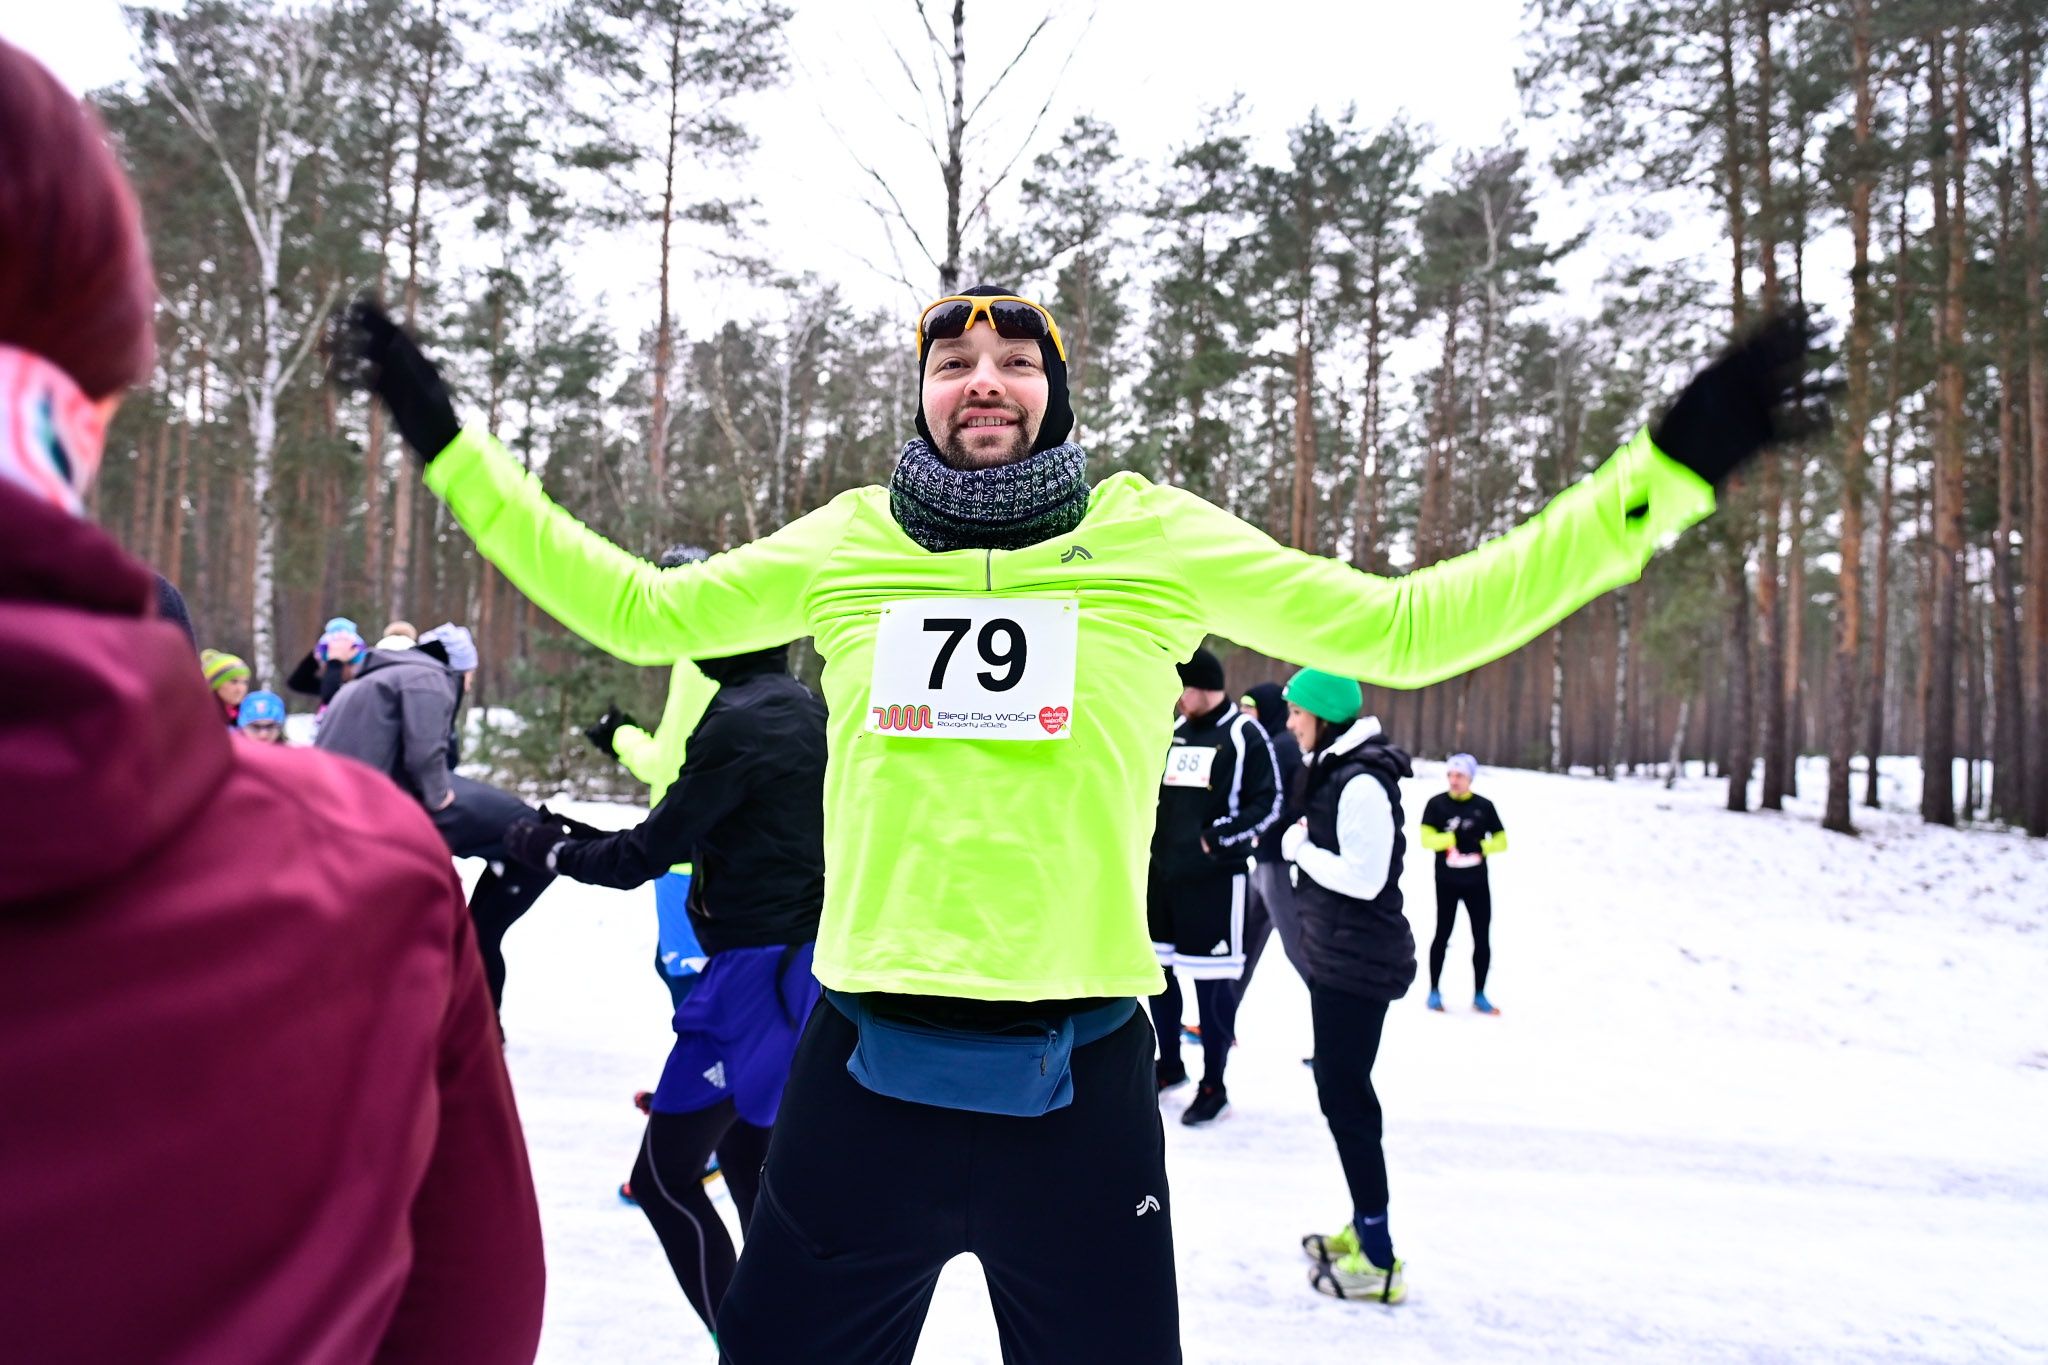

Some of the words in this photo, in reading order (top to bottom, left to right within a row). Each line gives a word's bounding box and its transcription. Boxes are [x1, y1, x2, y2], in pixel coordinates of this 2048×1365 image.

[923, 618, 1027, 692] 79
[937, 711, 968, 721] Biegi
[971, 712, 992, 721] Dla
[995, 711, 1036, 722] WOŚP
[1177, 753, 1200, 772] 88
